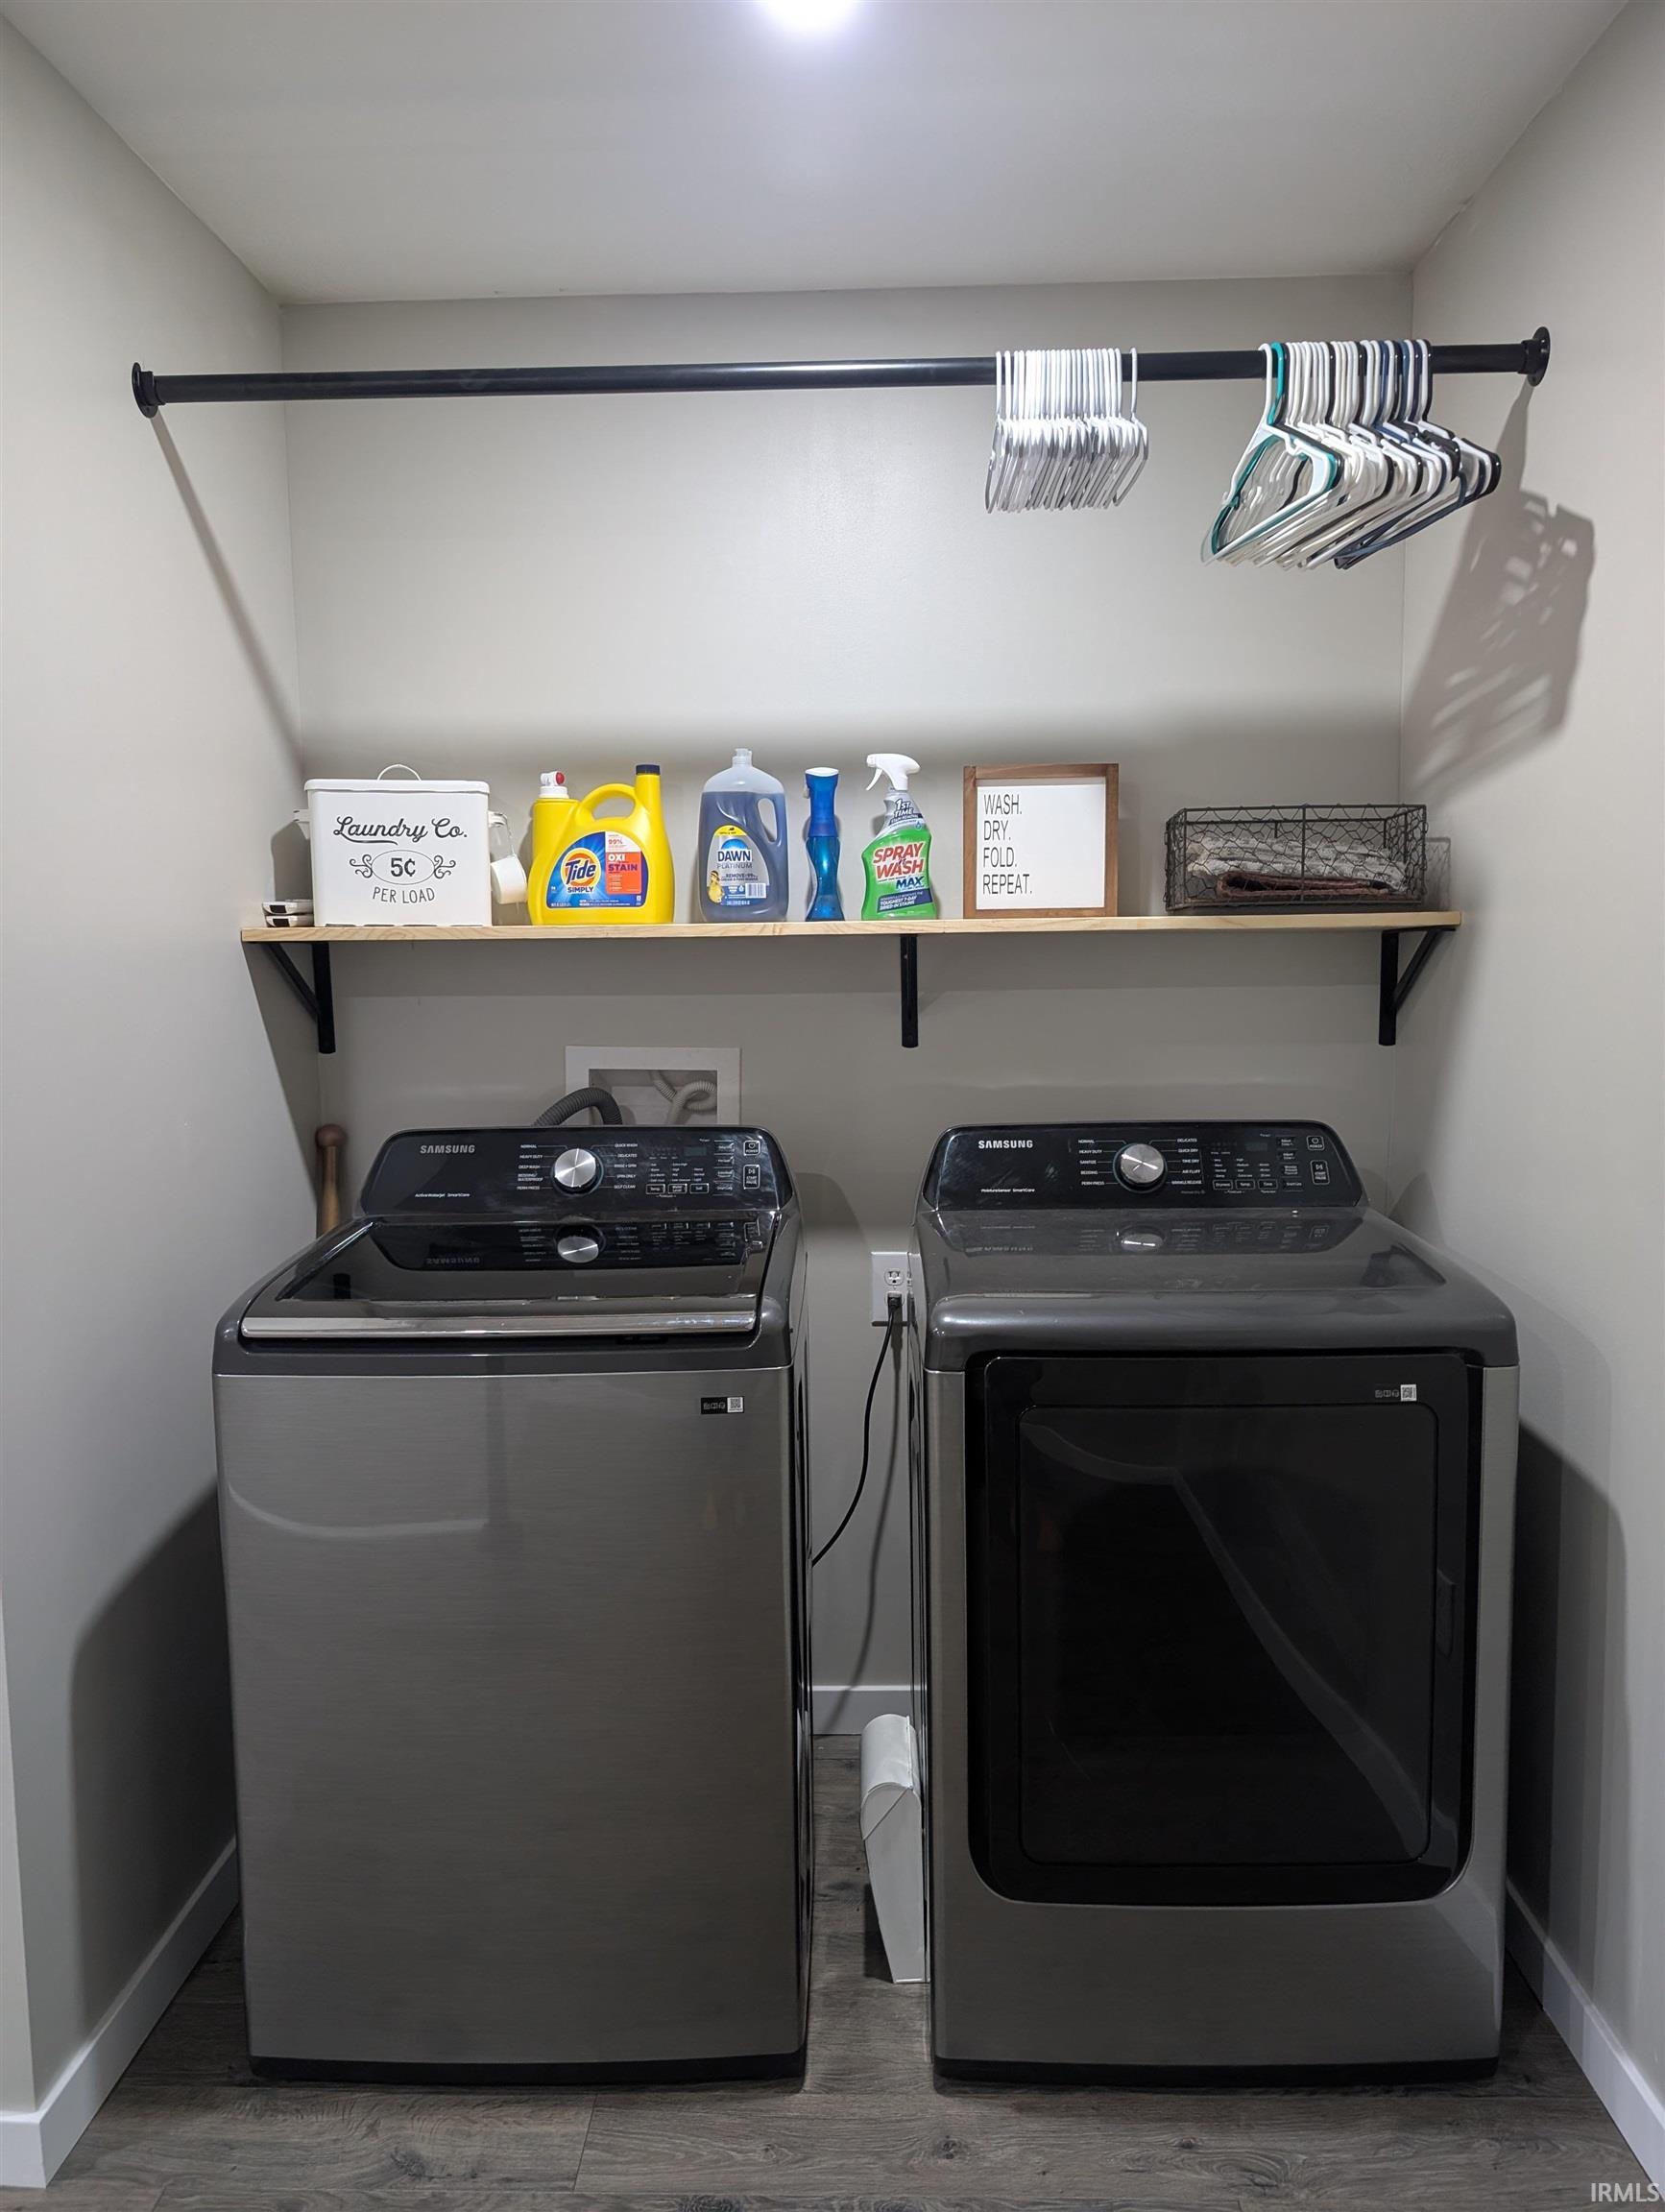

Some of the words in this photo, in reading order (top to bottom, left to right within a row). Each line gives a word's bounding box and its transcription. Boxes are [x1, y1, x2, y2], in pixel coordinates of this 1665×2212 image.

[894, 808, 914, 818] TIME
[895, 798, 910, 810] 1ST
[983, 793, 1023, 815] WASH.
[332, 816, 429, 846] Laundry
[431, 817, 468, 838] Co.
[983, 819, 1011, 841] DRY.
[717, 850, 751, 862] DAWN
[872, 842, 925, 864] SPRAY
[982, 847, 1018, 868] FOLD.
[390, 857, 416, 878] 5¢
[565, 859, 596, 885] Tide
[608, 863, 638, 872] STAIN
[876, 858, 925, 879] WASH
[896, 876, 924, 890] MAX
[982, 874, 1032, 895] REPEAT.
[373, 886, 397, 903] PER
[402, 887, 436, 903] LOAD
[420, 1144, 475, 1154] SAMSUNG
[977, 1140, 1033, 1149] SAMSUNG
